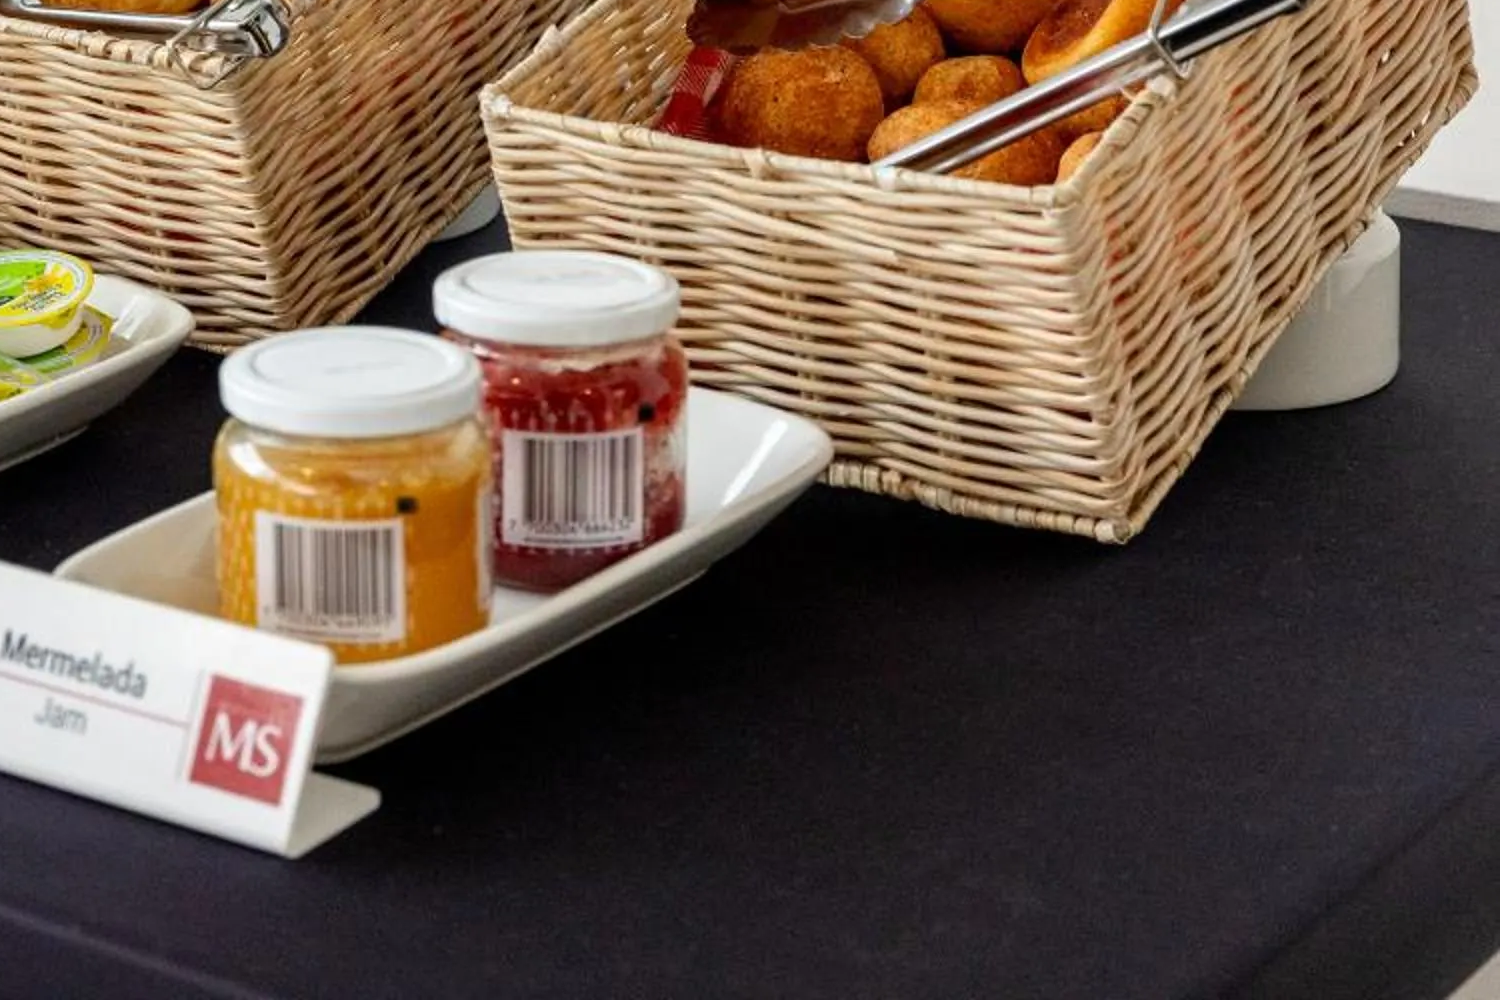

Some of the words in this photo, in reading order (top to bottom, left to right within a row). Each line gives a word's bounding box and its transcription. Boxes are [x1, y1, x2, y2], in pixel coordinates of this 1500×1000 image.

[0, 628, 149, 700] Mermelada
[33, 697, 88, 736] Jam
[204, 711, 284, 778] MS
